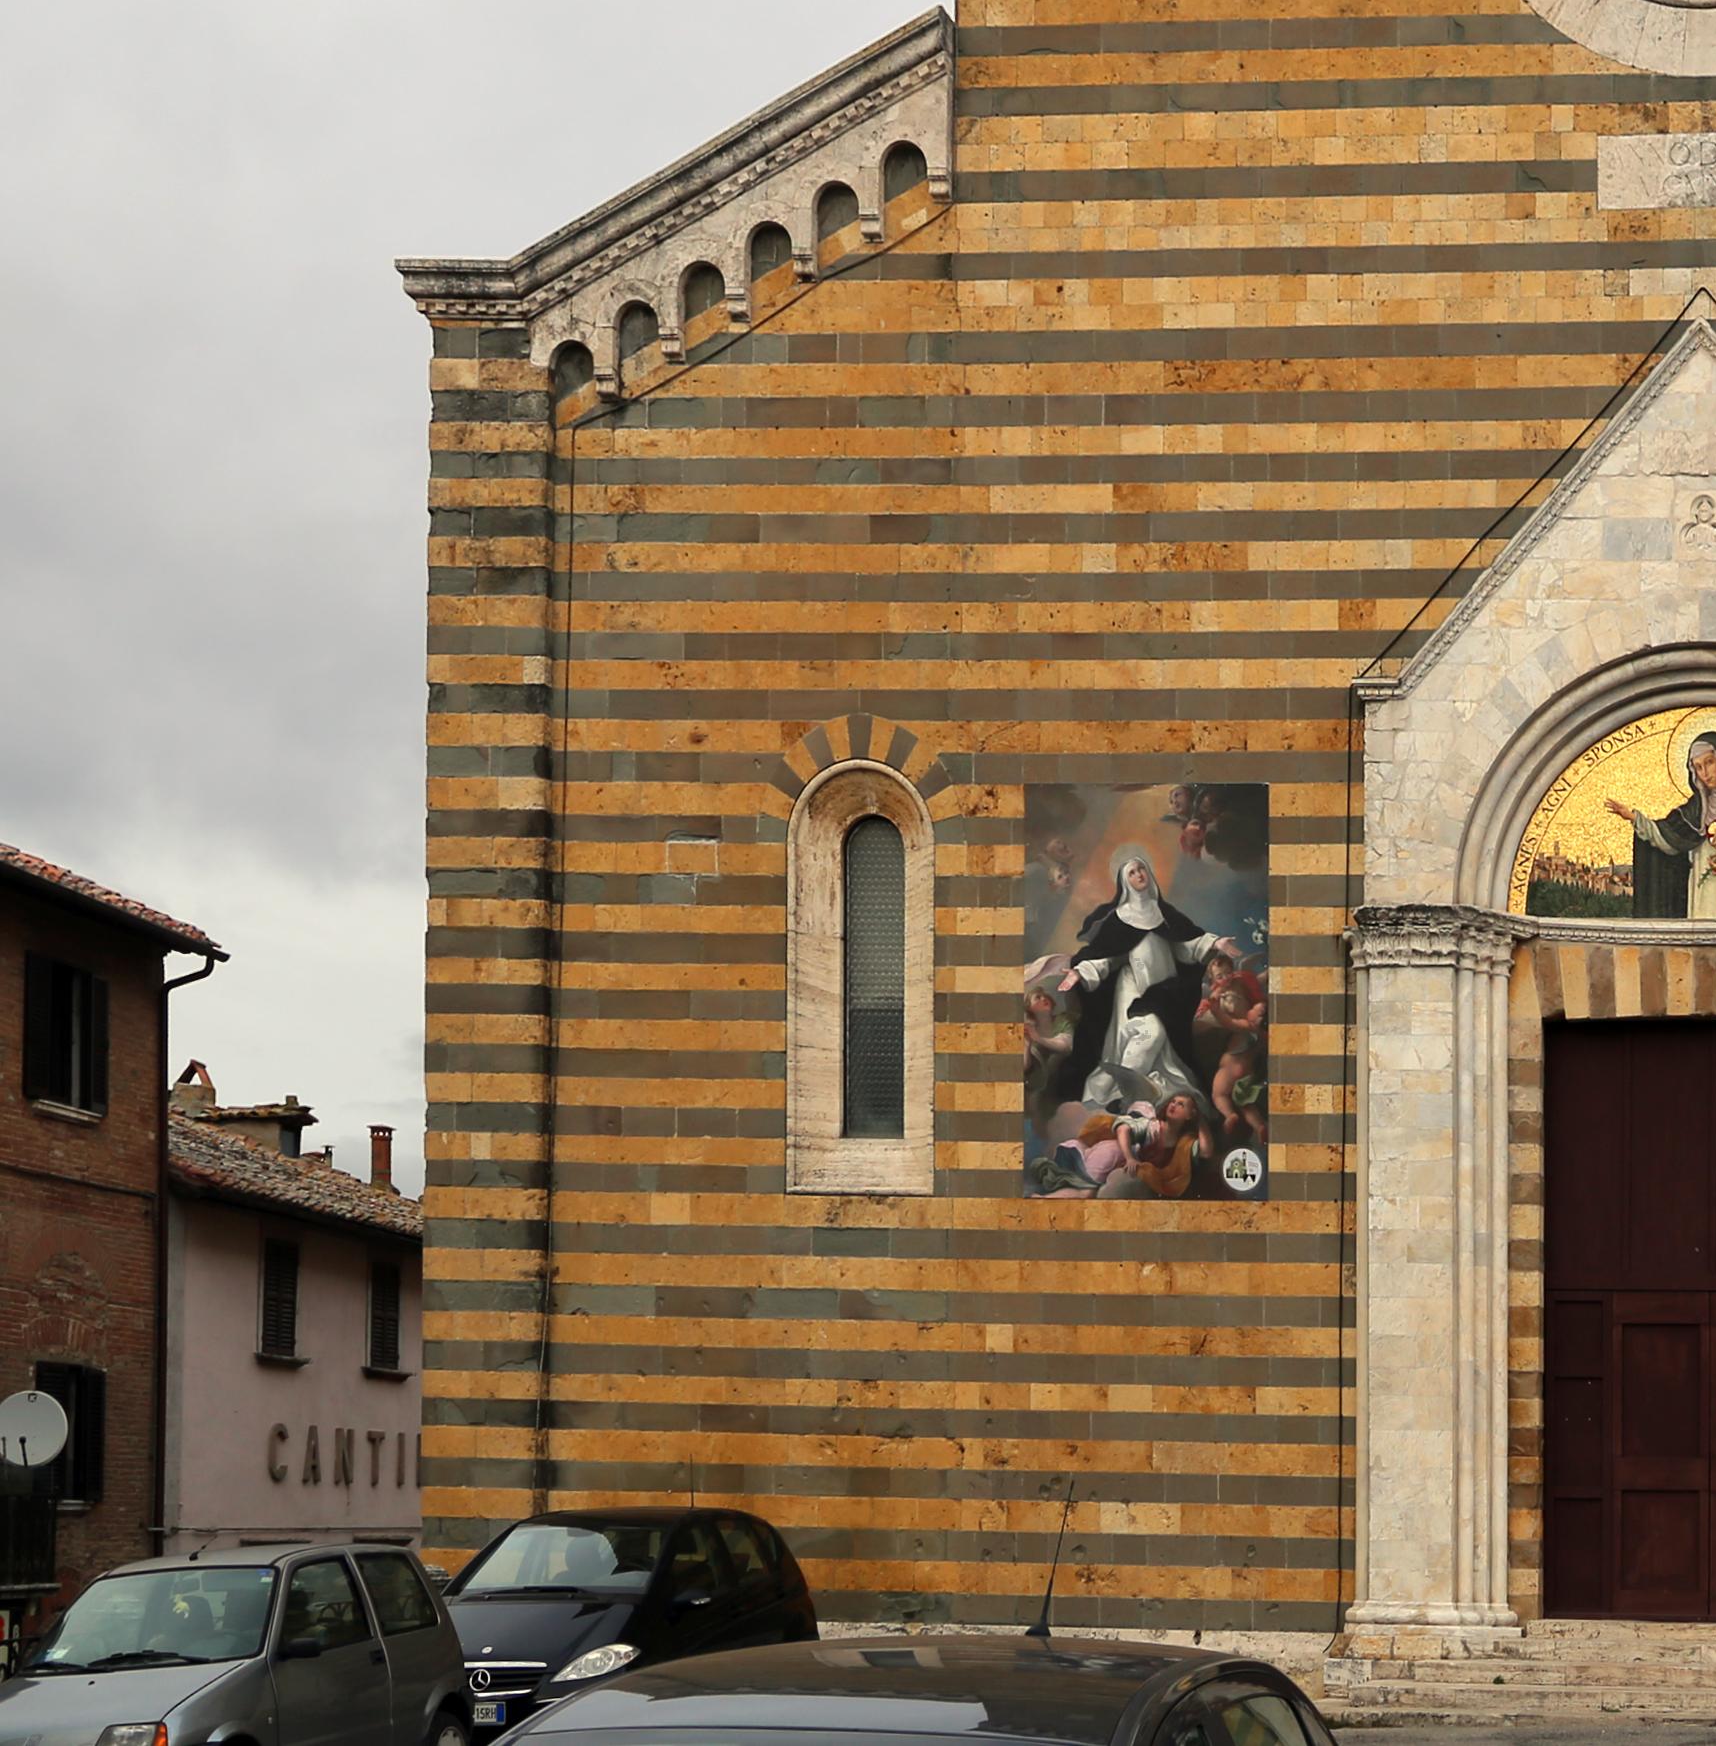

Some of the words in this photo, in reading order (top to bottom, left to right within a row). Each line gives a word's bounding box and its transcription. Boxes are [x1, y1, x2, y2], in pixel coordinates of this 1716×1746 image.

[1513, 833, 1538, 895] AGNES
[1541, 776, 1573, 820] AGNI
[1582, 724, 1646, 768] SPONSA
[267, 1422, 422, 1490] CANTI
